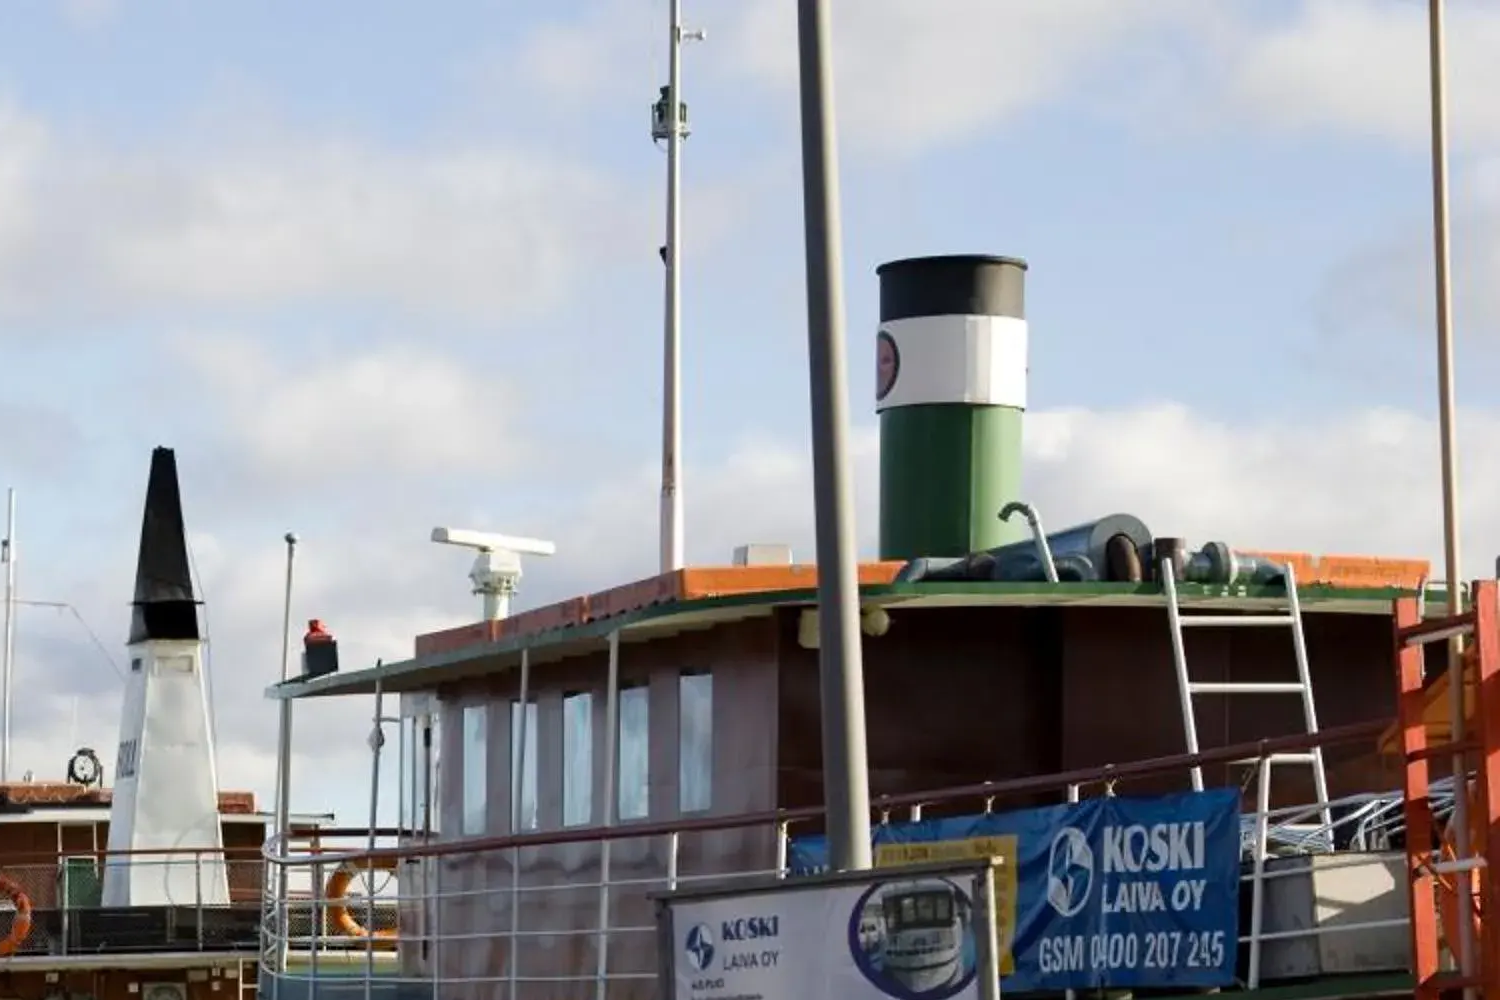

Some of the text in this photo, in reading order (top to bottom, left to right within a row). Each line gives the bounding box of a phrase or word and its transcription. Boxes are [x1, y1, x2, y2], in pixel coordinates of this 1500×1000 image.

[1102, 821, 1205, 873] KOSKI
[1102, 879, 1206, 913] LAIVA OY
[722, 915, 779, 941] KOSKI
[723, 950, 779, 970] LAIVA OY
[1039, 936, 1084, 973] GSM
[1144, 932, 1181, 968] 207
[1187, 930, 1225, 967] 245
